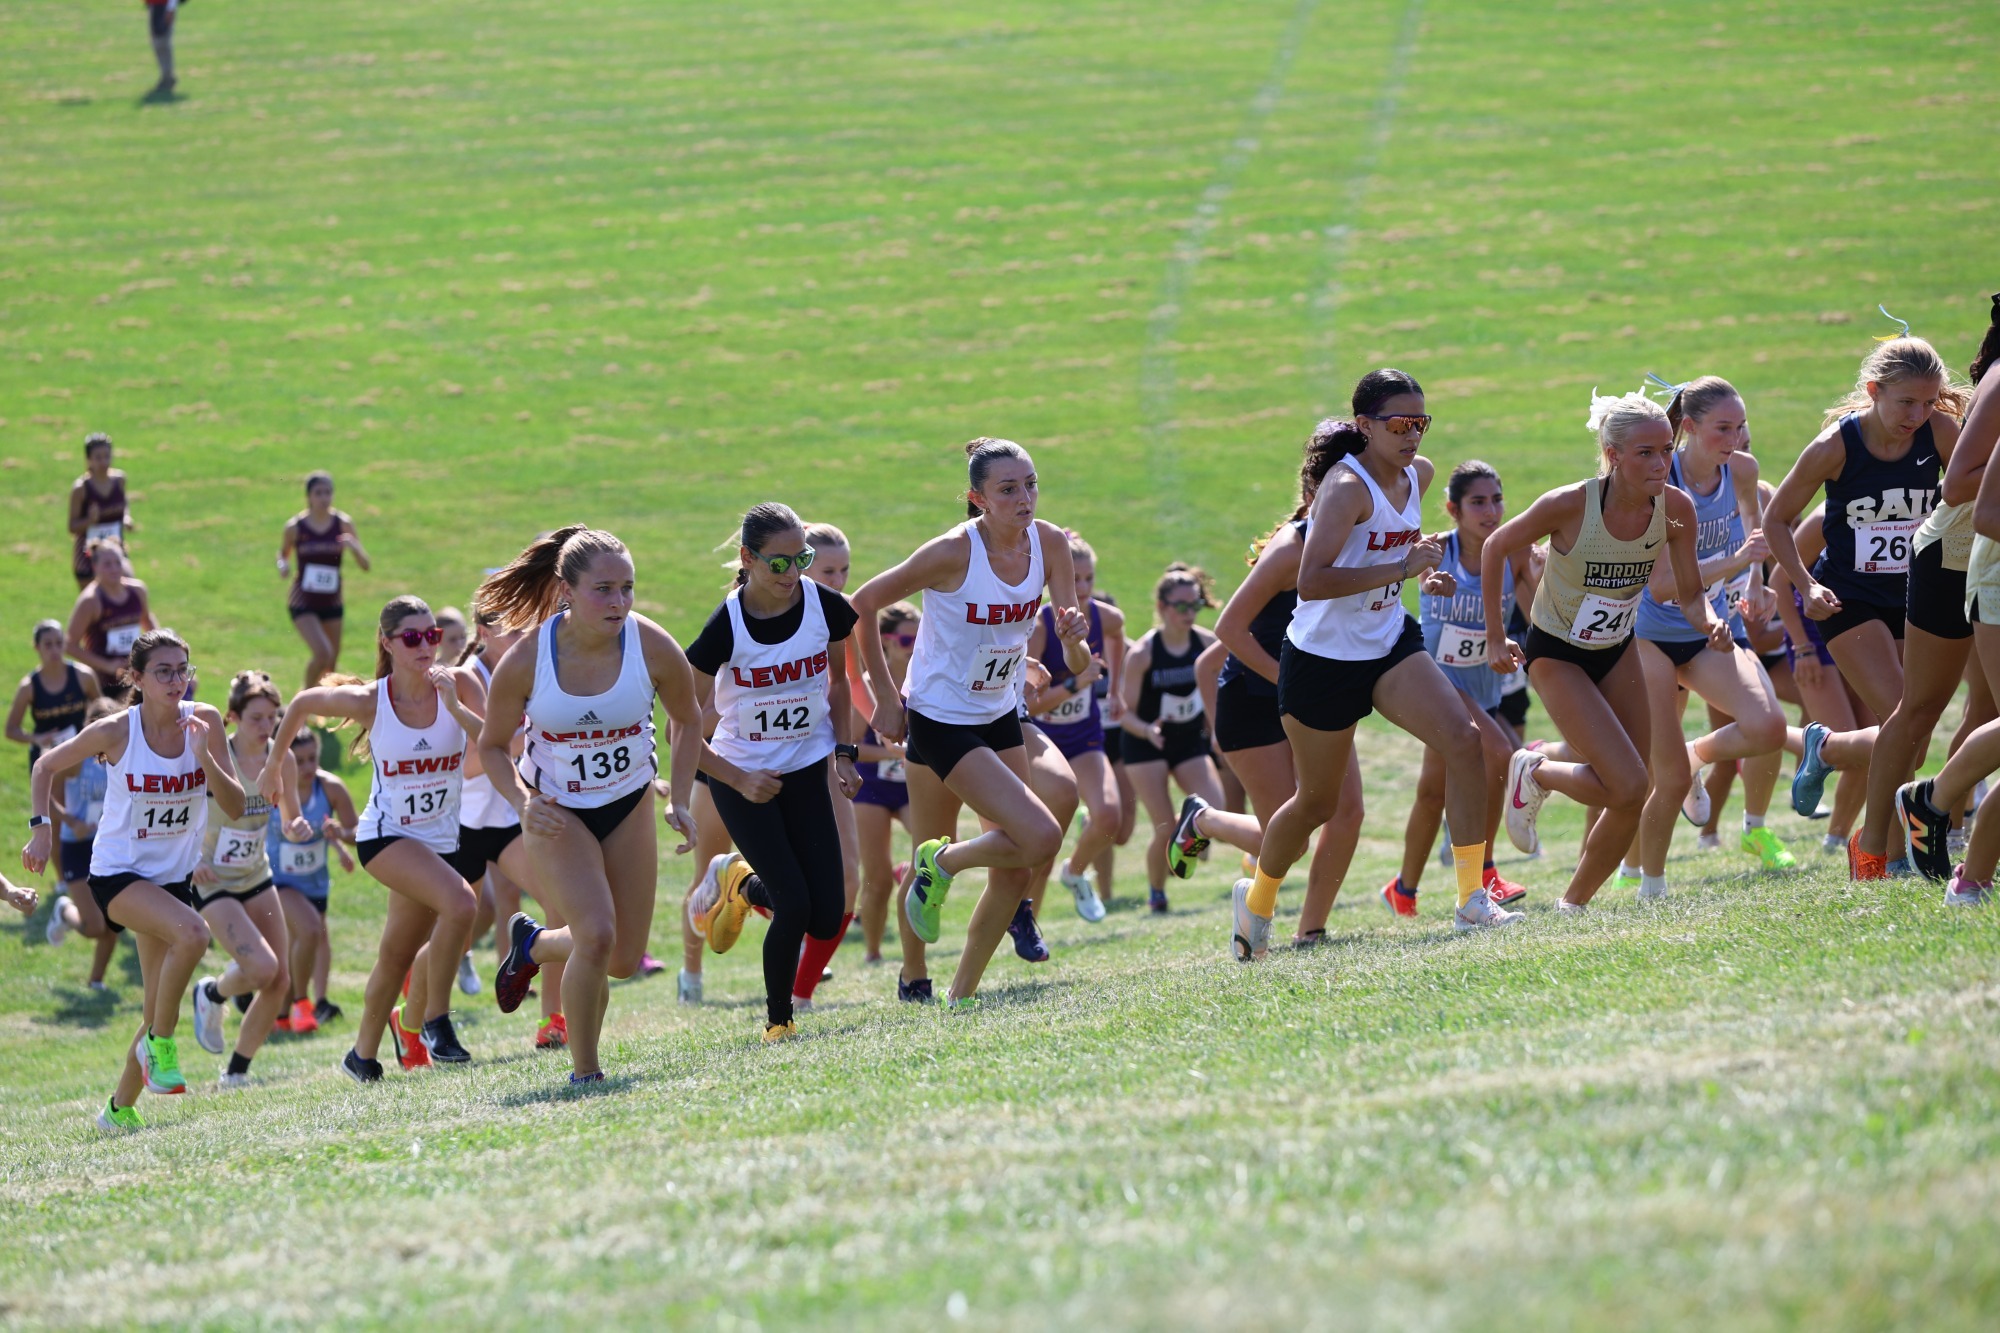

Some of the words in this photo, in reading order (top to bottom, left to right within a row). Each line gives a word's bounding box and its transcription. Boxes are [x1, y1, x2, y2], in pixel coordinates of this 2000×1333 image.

[1870, 536, 1914, 561] 26
[1587, 561, 1655, 578] PURDUE
[1384, 581, 1404, 599] 13
[1586, 576, 1649, 588] NORTHWEST
[1598, 600, 1618, 608] Lewis
[1587, 607, 1634, 632] 241
[1458, 640, 1487, 657] 81
[730, 650, 827, 688] LEWIS
[754, 699, 775, 707] Lewis
[776, 696, 808, 705] Earlybird
[754, 706, 810, 732] 142
[594, 734, 626, 747] Earlybird
[382, 751, 462, 777] LEWIS
[571, 746, 630, 781] 138
[125, 767, 205, 793] LEWIS
[404, 788, 448, 815] 137
[144, 806, 189, 828] 144
